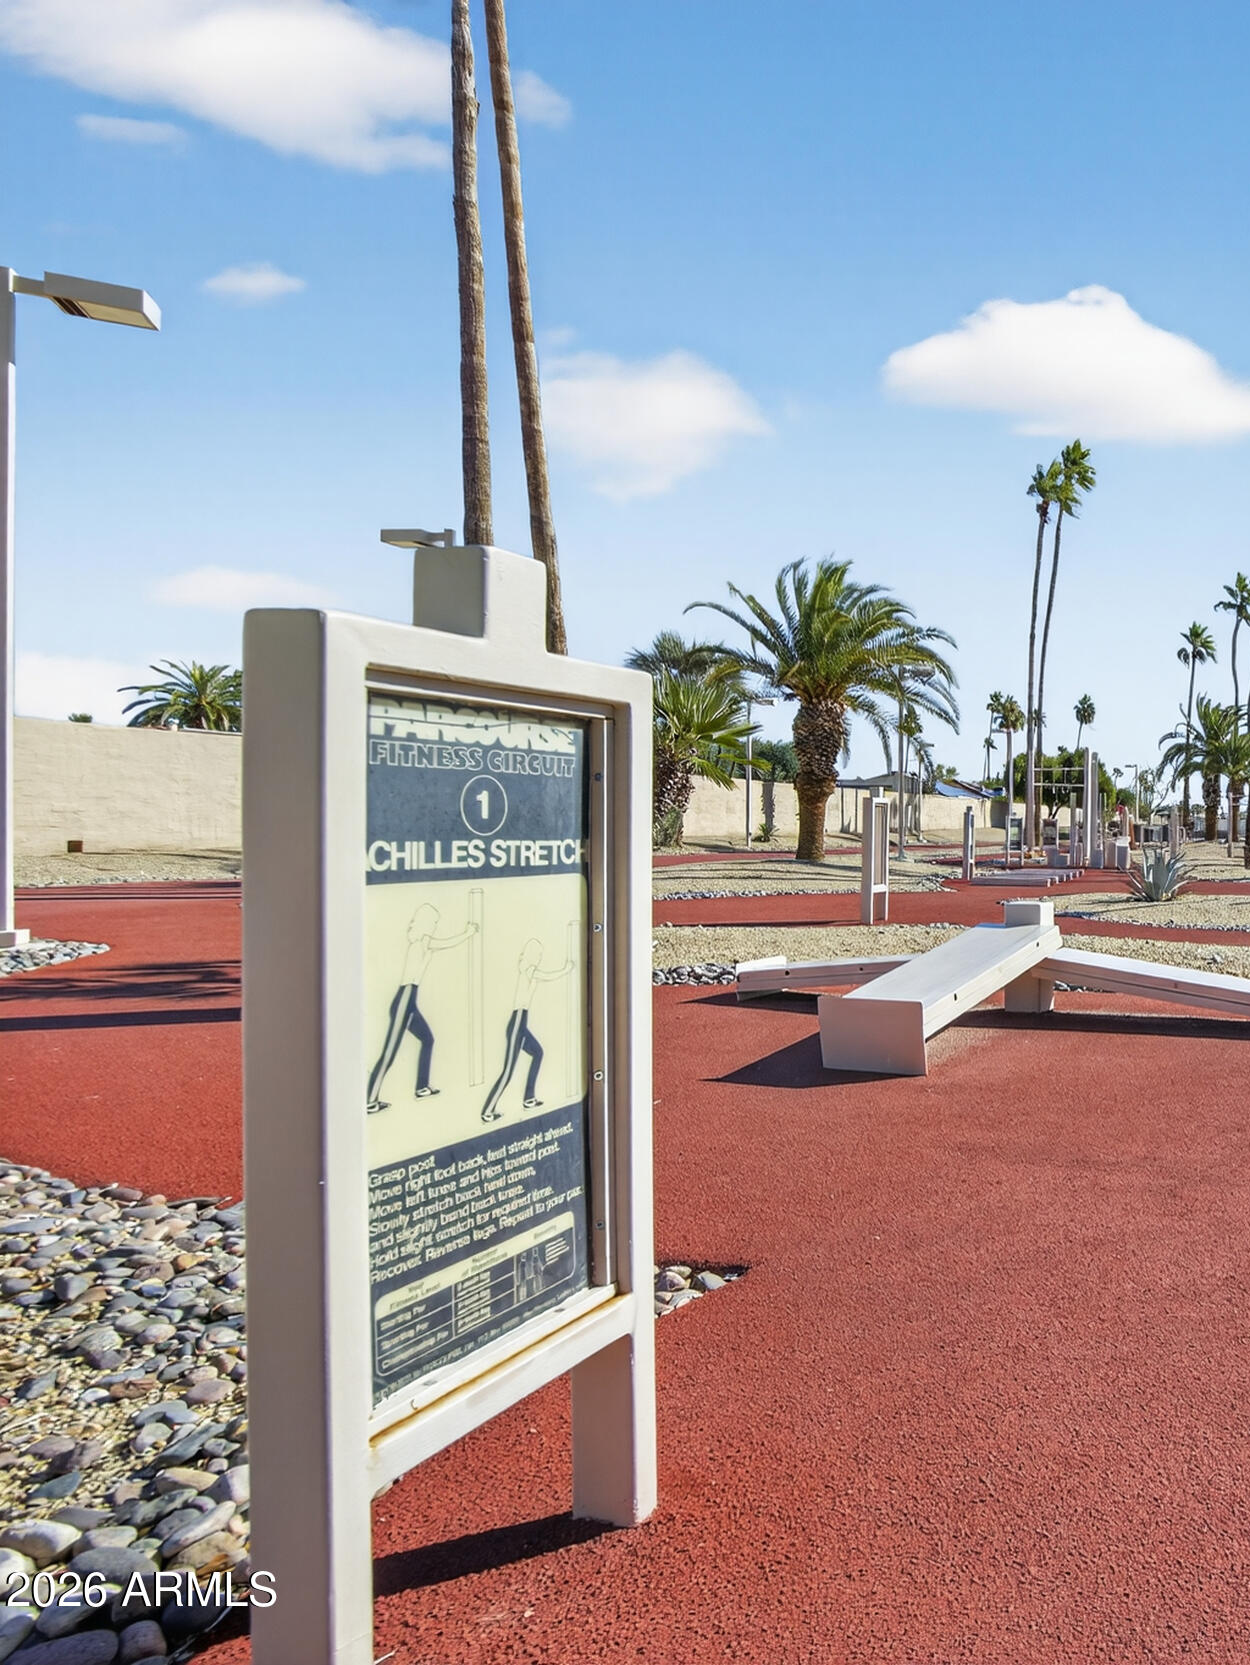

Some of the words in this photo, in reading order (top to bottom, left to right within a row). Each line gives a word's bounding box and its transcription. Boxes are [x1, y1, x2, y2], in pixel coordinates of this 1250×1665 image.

[368, 739, 484, 771] FITNESS
[487, 750, 577, 777] CIRCUIT
[475, 790, 490, 819] 1
[366, 838, 486, 872] CHILLES
[459, 1170, 480, 1187] and
[368, 1232, 393, 1253] and
[440, 1204, 469, 1225] bend
